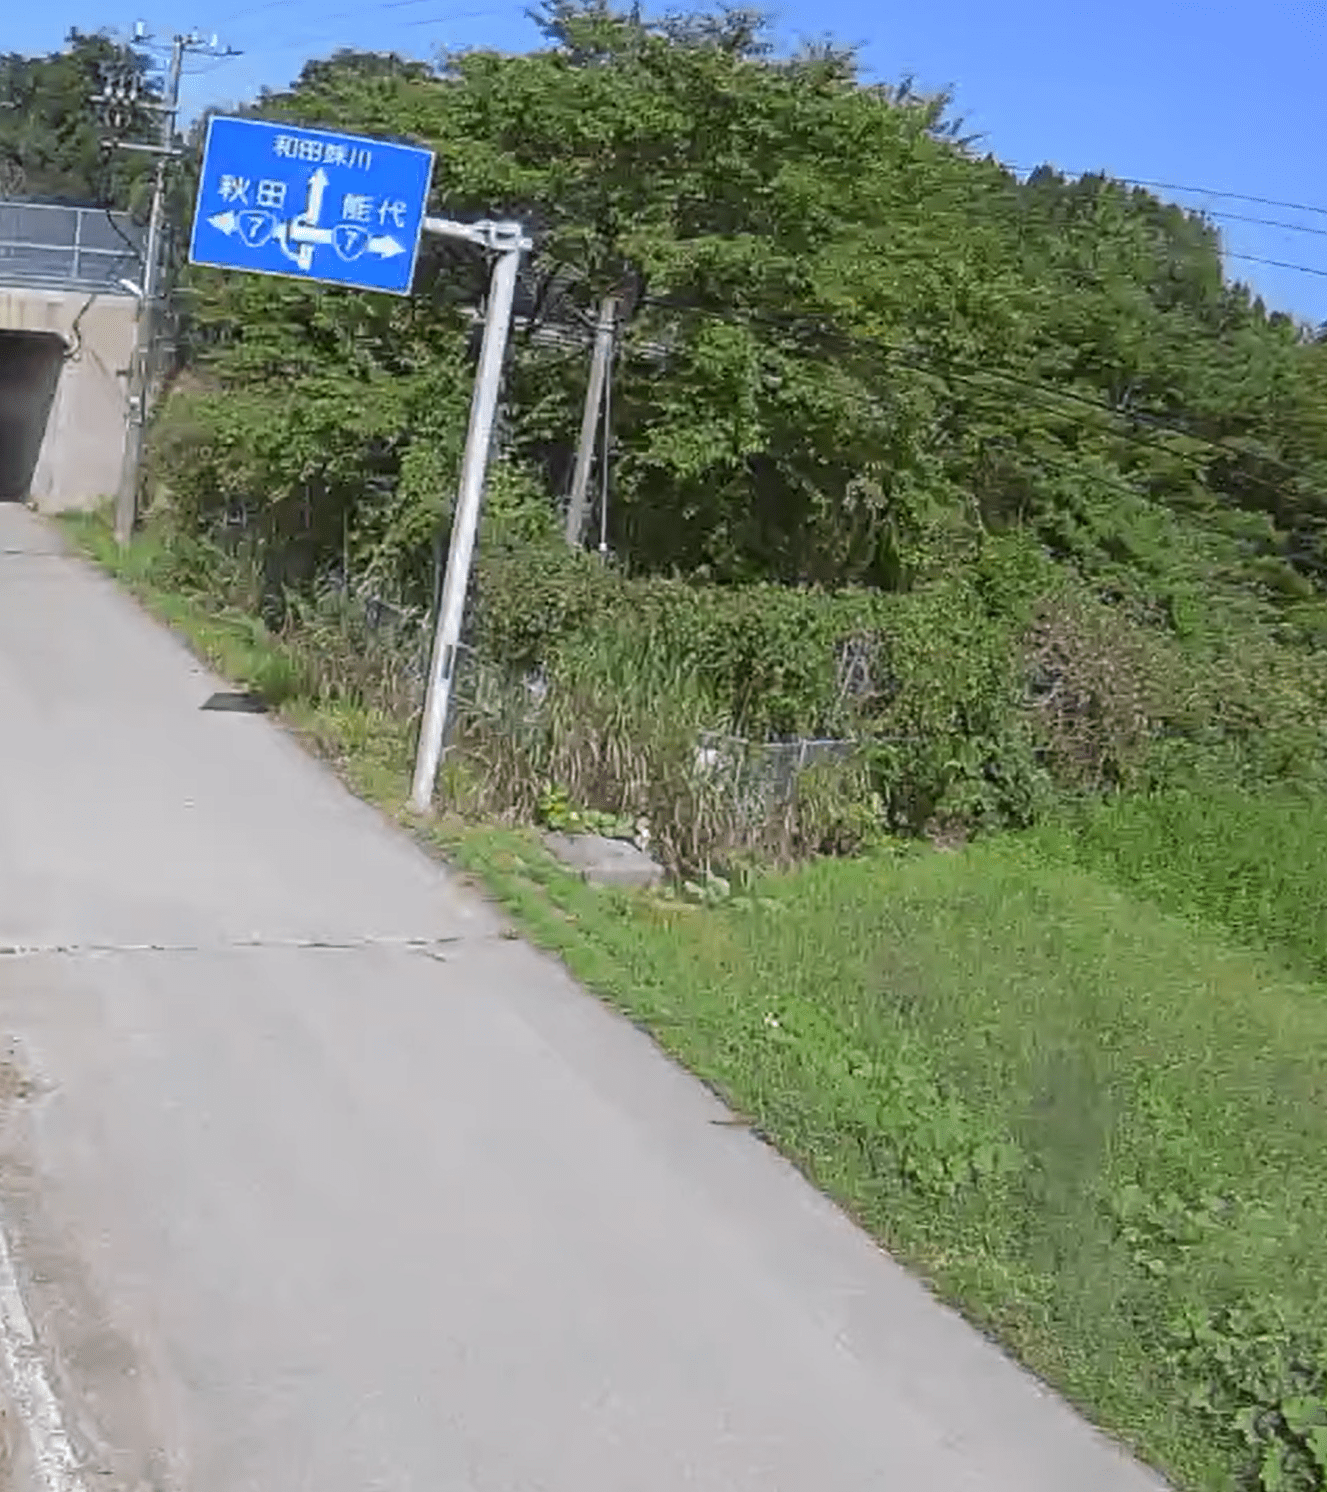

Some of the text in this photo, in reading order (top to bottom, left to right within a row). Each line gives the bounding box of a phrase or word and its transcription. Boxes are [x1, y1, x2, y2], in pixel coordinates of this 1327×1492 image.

[217, 174, 287, 209] 秋田
[342, 193, 407, 228] 能代
[248, 216, 265, 237] 7
[345, 230, 359, 251] 7
